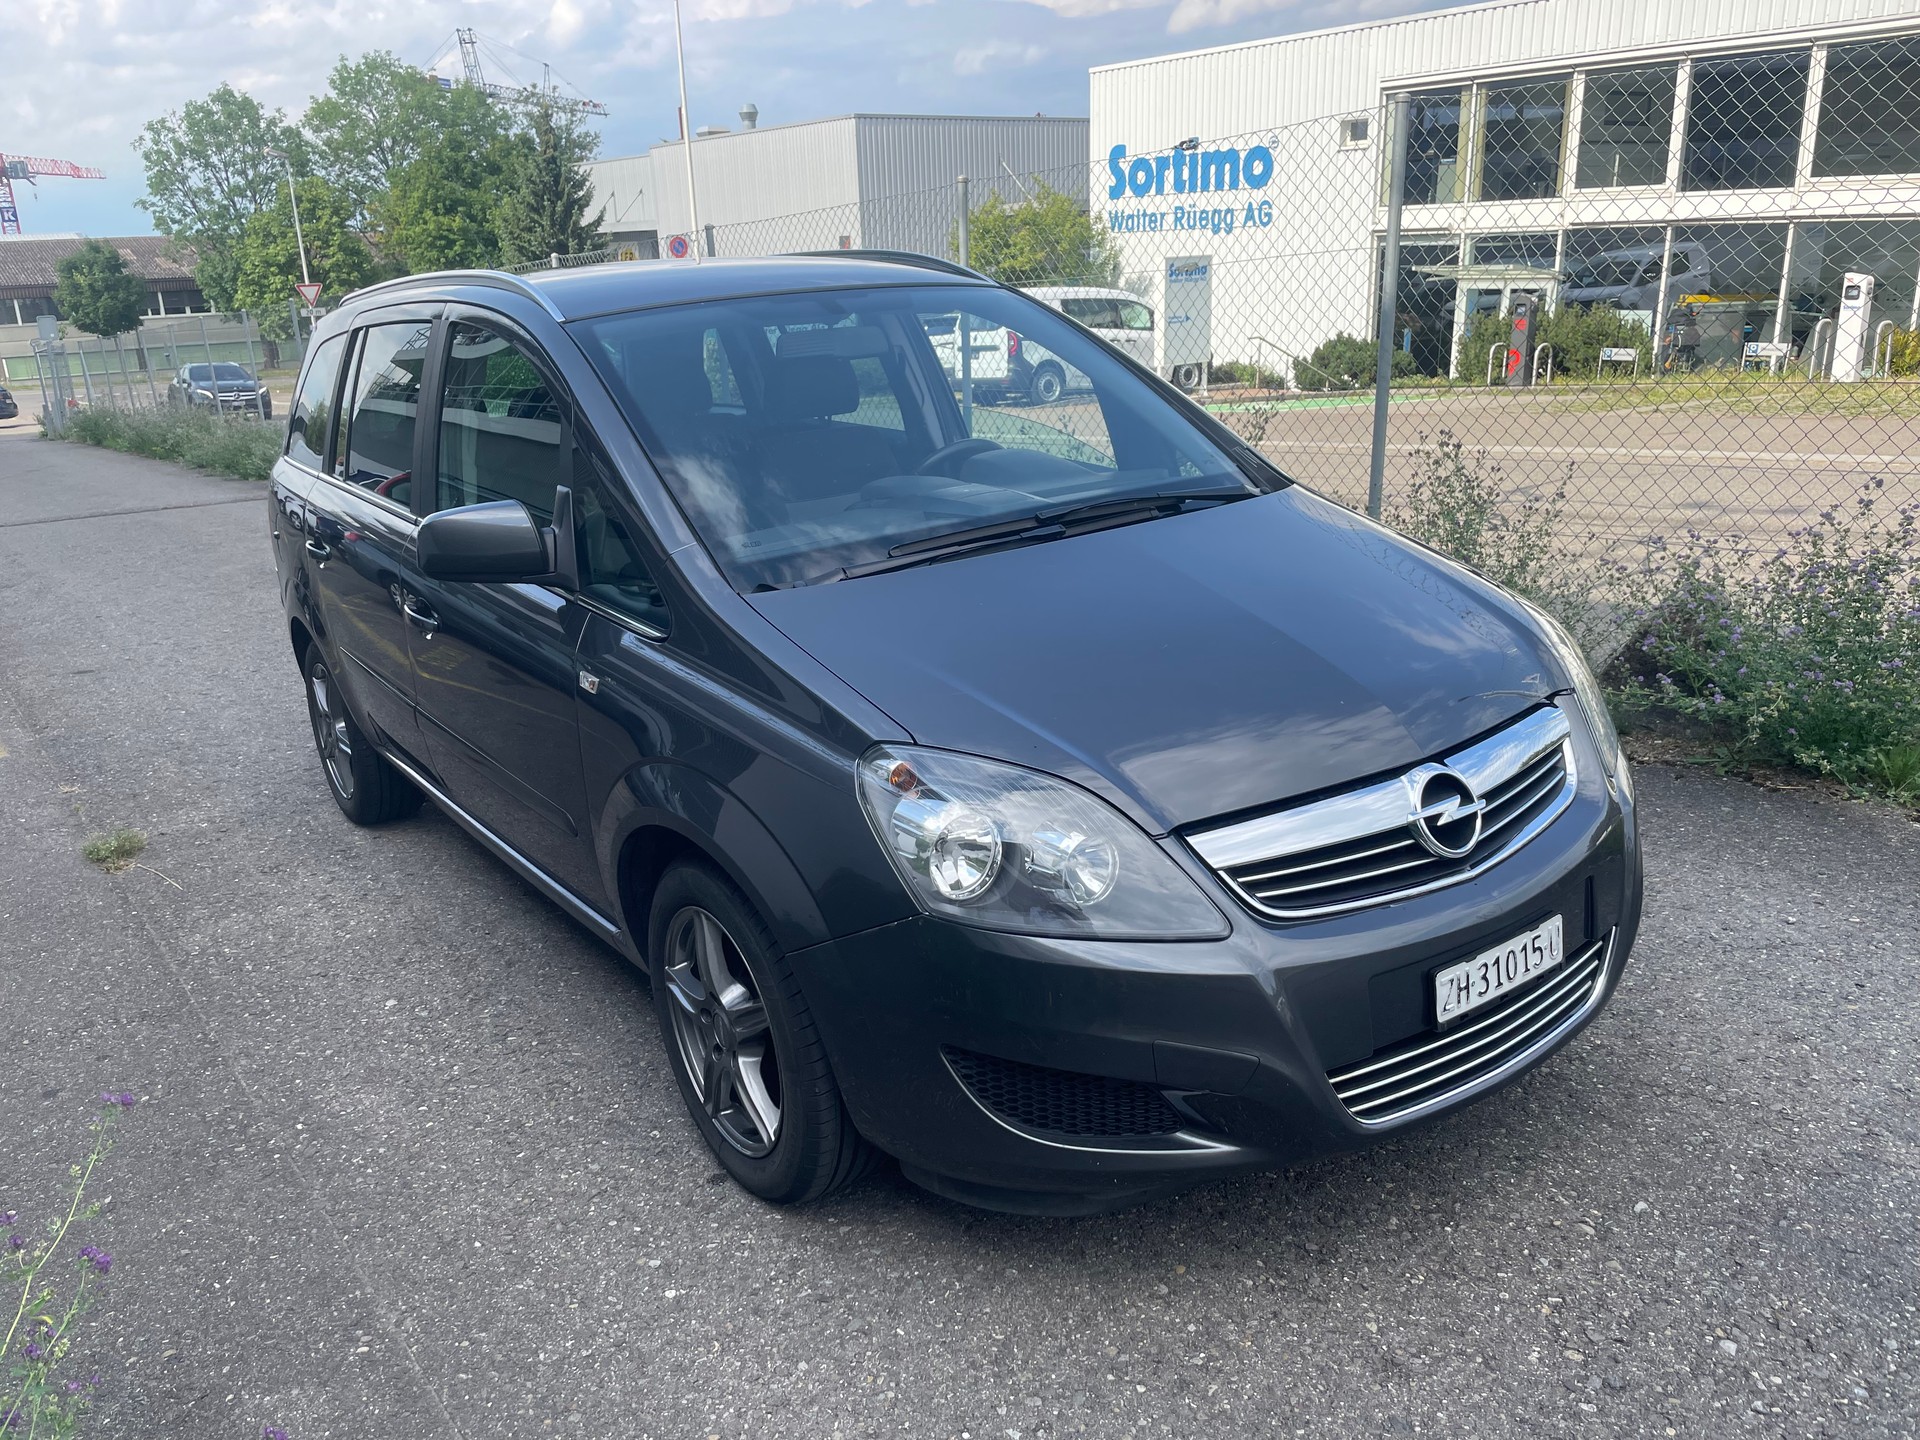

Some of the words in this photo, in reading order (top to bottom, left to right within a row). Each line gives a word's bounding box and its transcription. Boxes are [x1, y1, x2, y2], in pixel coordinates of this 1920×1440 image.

[1109, 144, 1274, 201] Sortimo
[1108, 208, 1166, 233] Walter
[1174, 203, 1234, 236] Rüegg
[1243, 200, 1273, 228] AG
